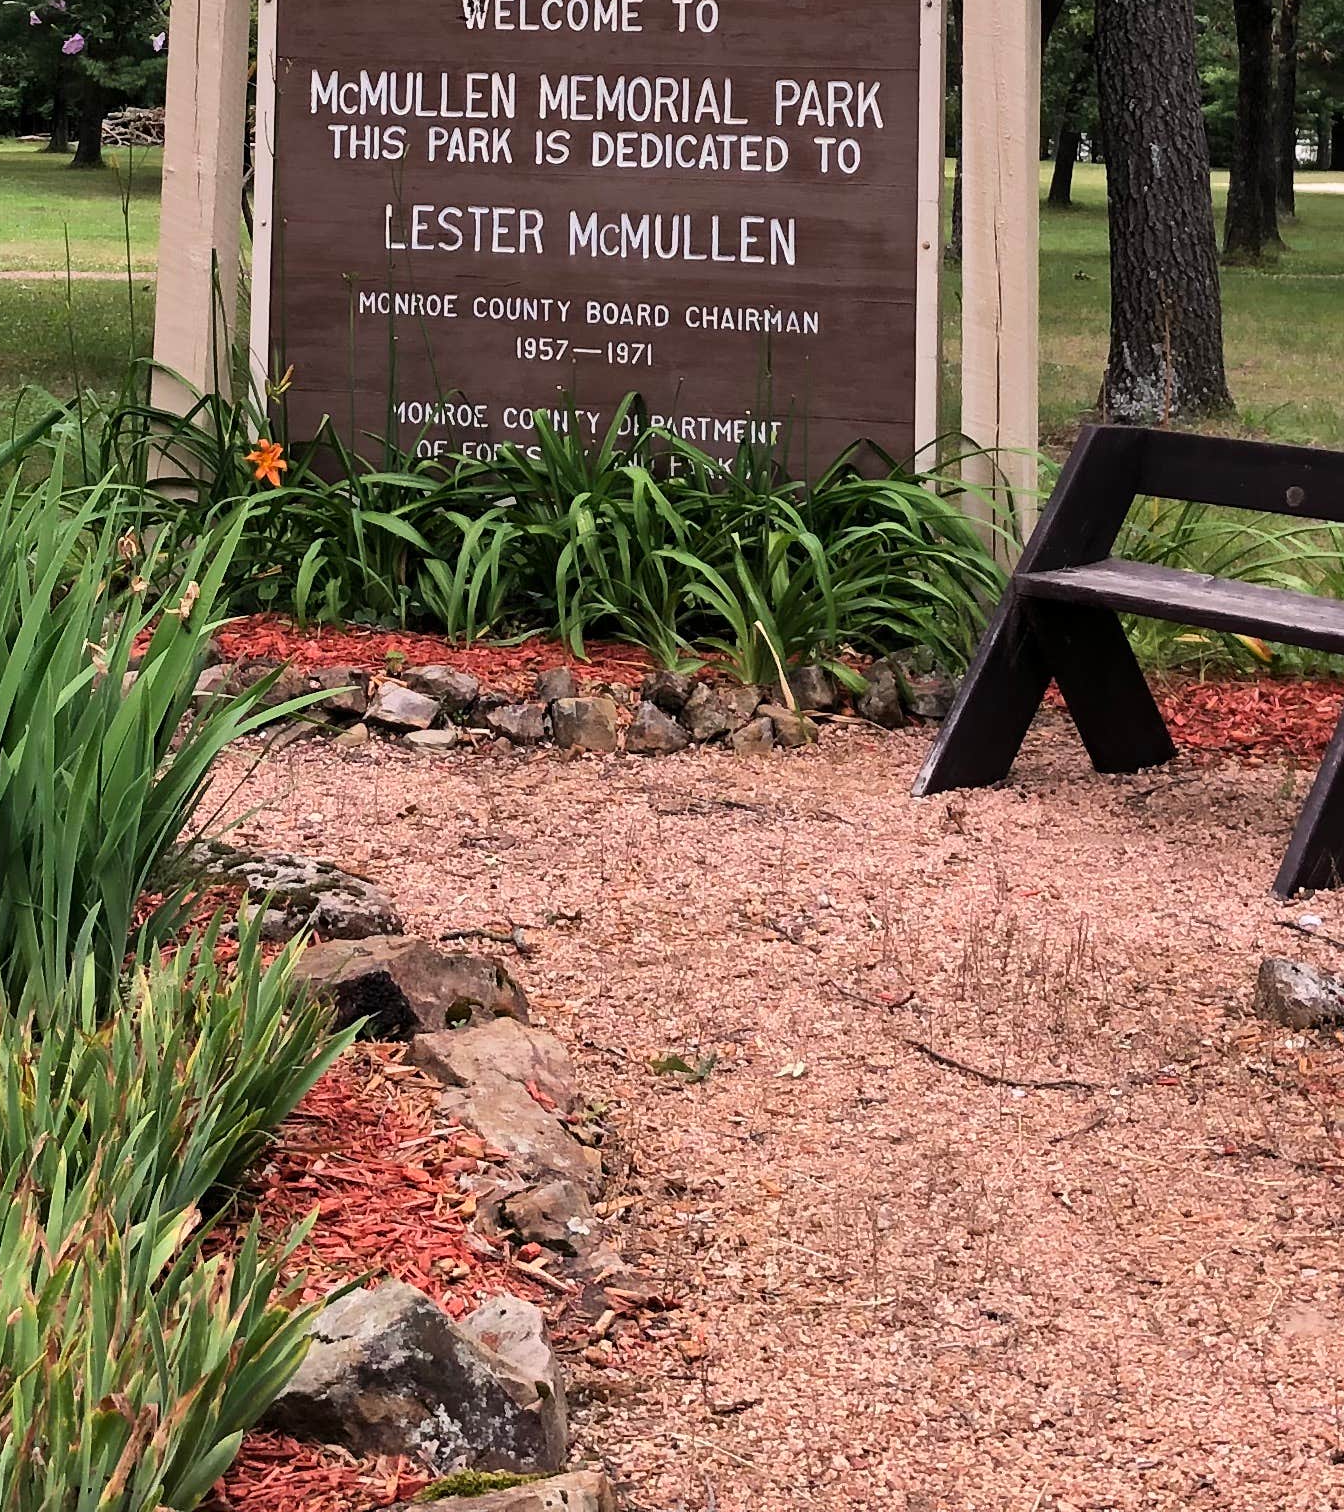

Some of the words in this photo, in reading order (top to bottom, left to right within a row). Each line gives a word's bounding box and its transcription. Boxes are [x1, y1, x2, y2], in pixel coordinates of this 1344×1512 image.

[310, 69, 517, 119] McMULLEN
[539, 74, 749, 125] MEMORIAL
[775, 79, 884, 128] PARK
[327, 124, 407, 160] THIS
[428, 126, 513, 164] PARK
[535, 129, 571, 165] IS
[591, 131, 789, 173] DEDICATED
[813, 137, 861, 174] TO
[384, 203, 544, 254] LESTER
[569, 210, 796, 266] McMULLEN
[358, 292, 458, 318] MONROE
[472, 297, 572, 323] COUNTY
[586, 301, 670, 327] BOARD
[685, 305, 820, 335] CHAIRMAN
[392, 401, 489, 428] MONROE
[416, 439, 448, 462] OF
